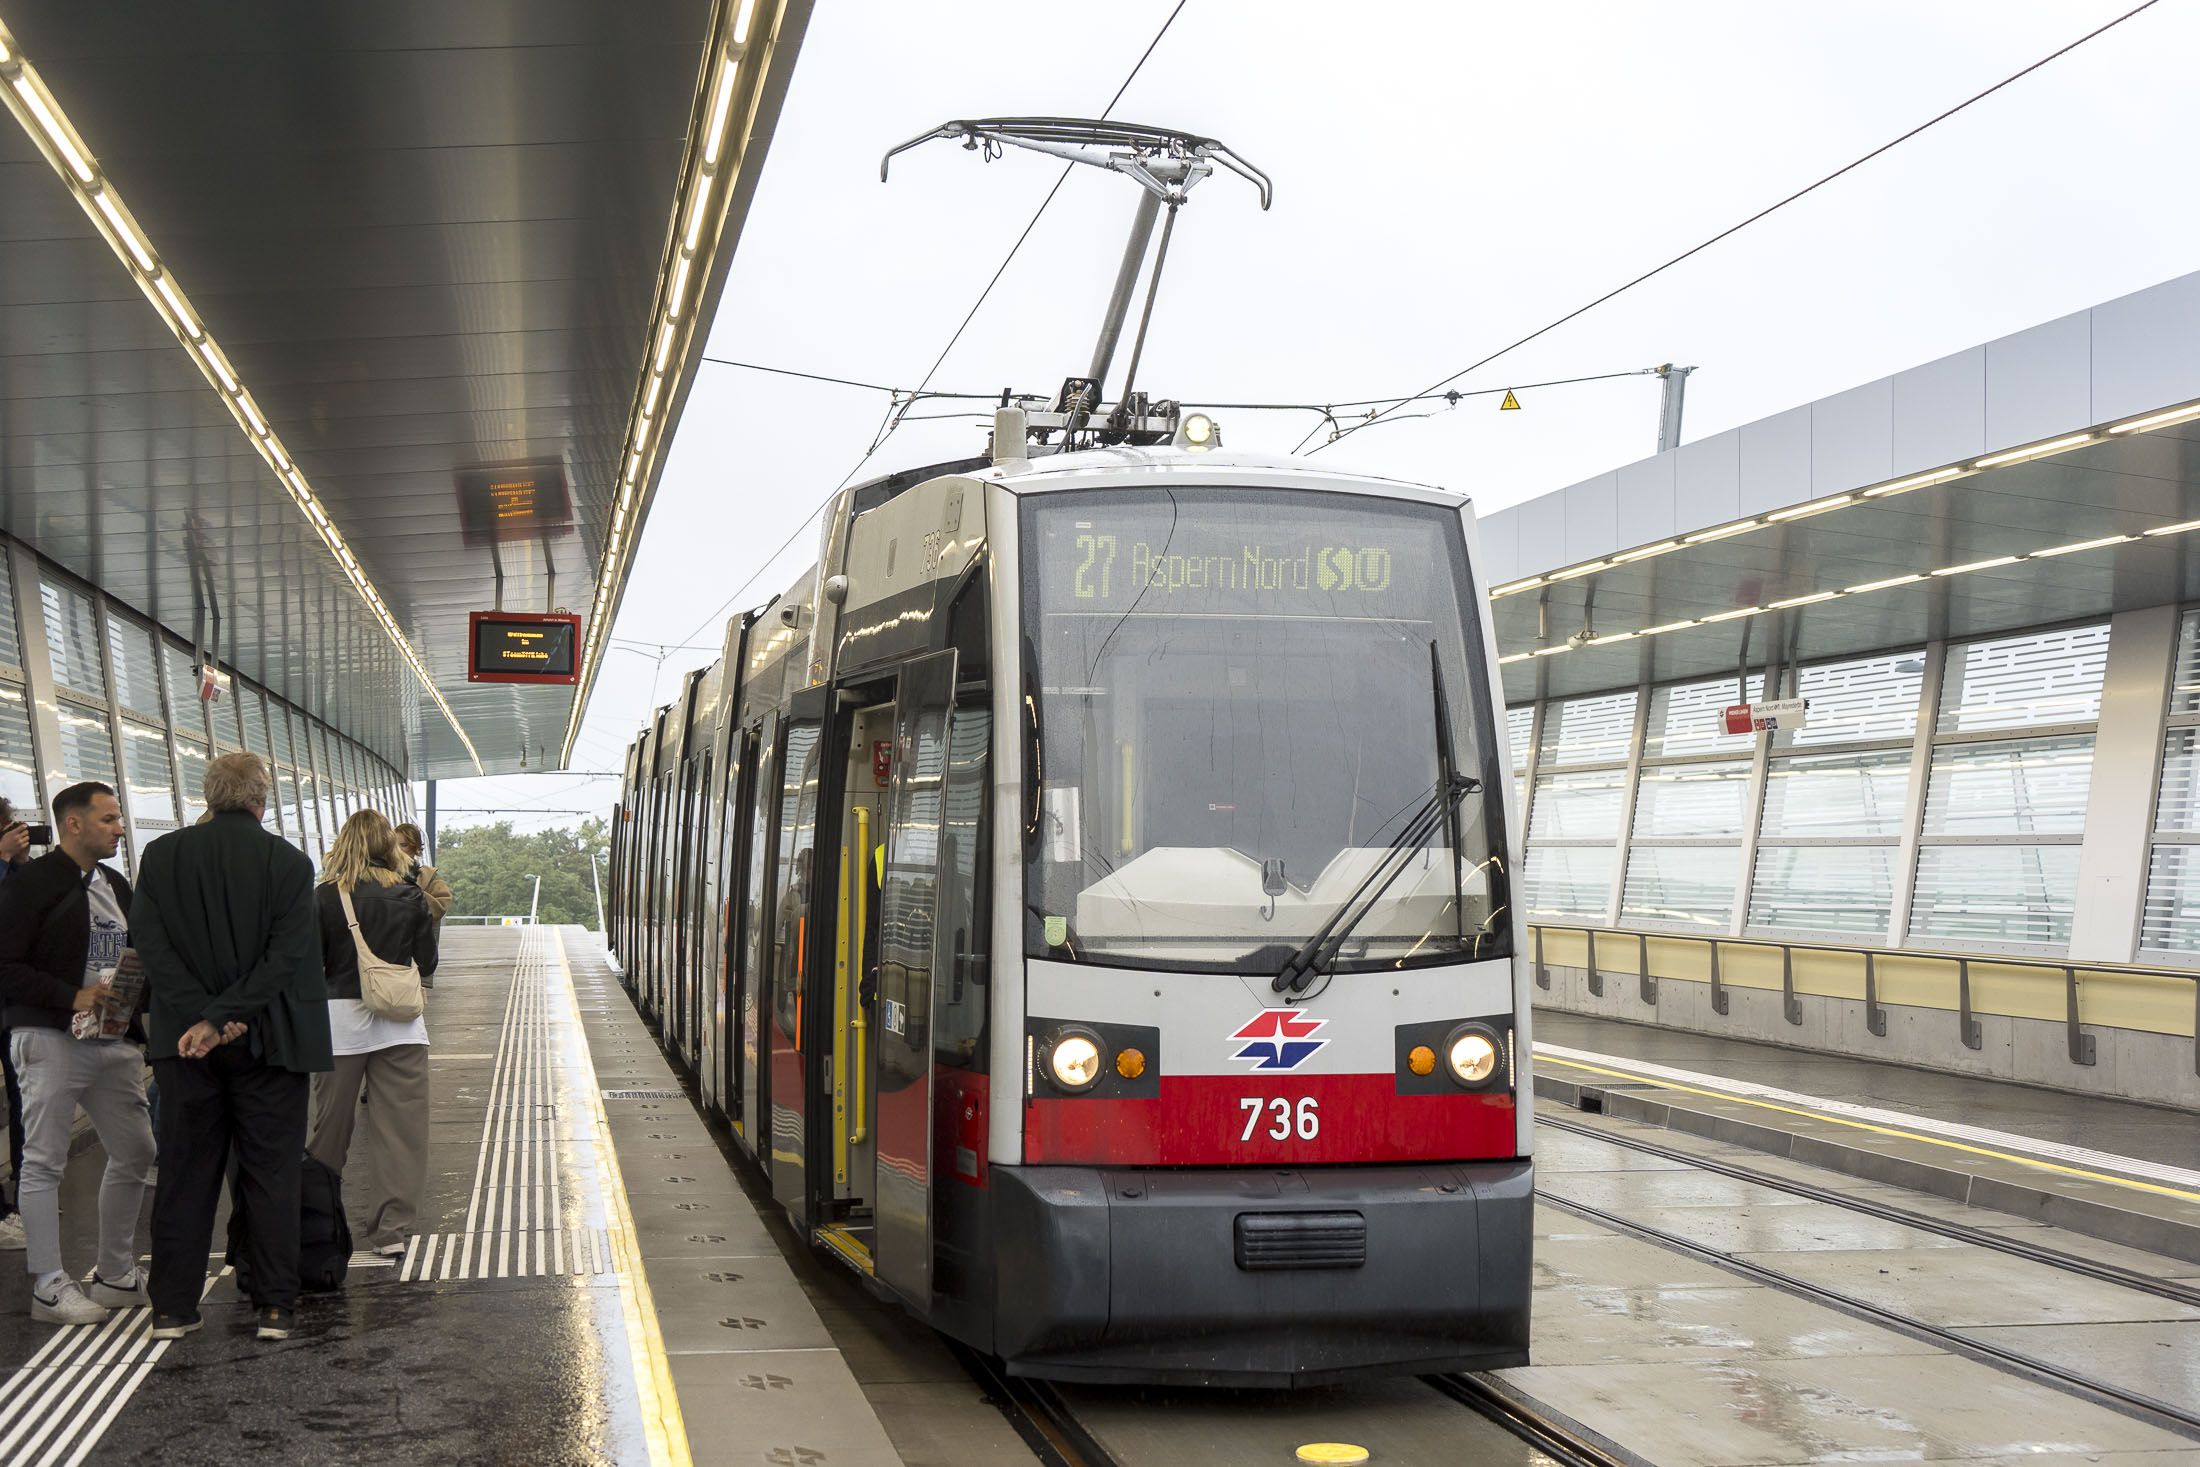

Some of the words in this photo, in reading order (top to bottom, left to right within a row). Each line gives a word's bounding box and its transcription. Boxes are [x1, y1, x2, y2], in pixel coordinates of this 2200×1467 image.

[920, 529, 940, 574] 736
[1075, 534, 1116, 598] 27
[1133, 542, 1236, 593] Aspern
[1242, 545, 1310, 589] Nord
[1240, 1096, 1319, 1141] 736
